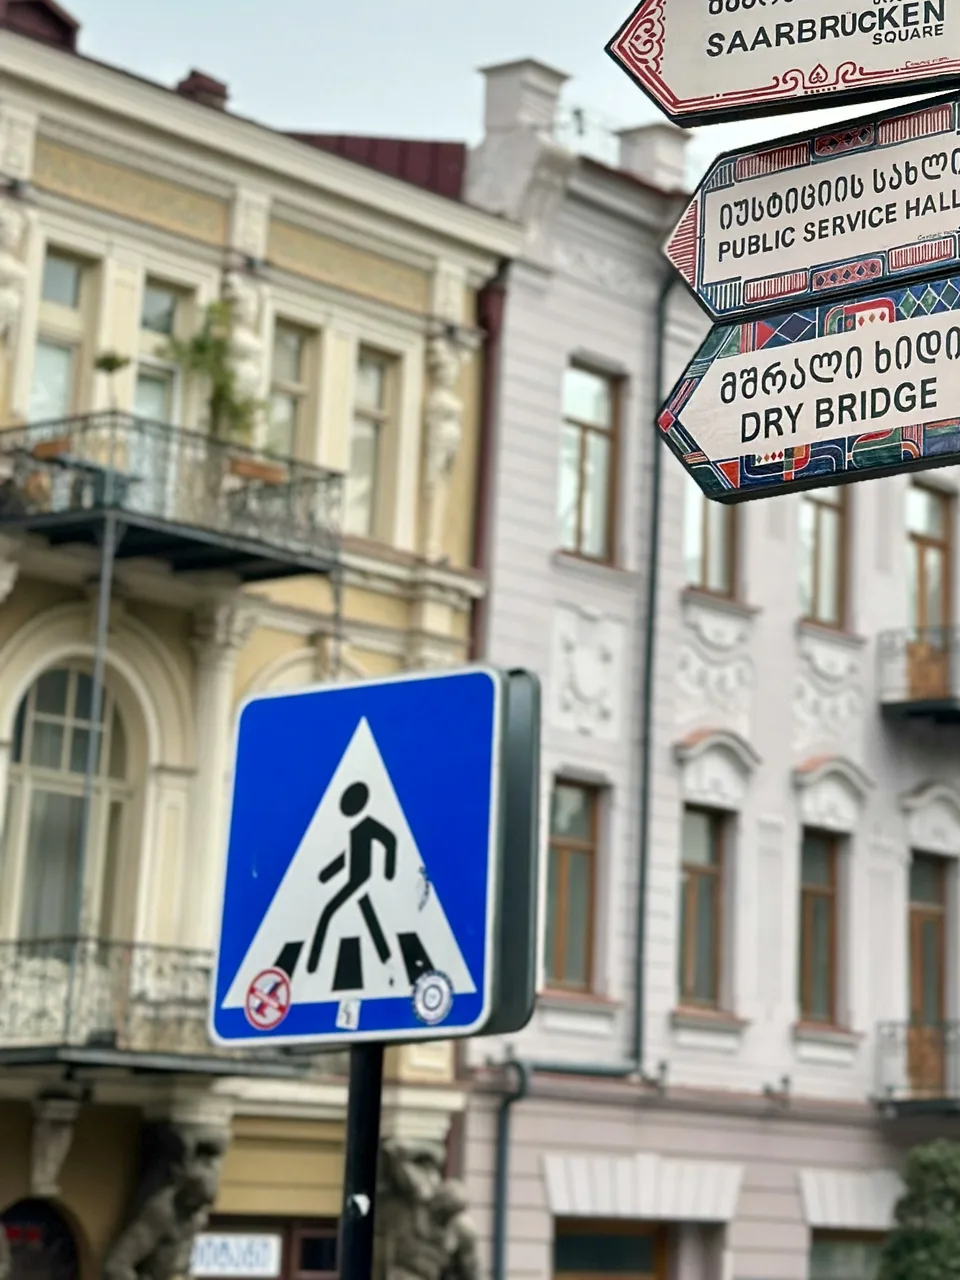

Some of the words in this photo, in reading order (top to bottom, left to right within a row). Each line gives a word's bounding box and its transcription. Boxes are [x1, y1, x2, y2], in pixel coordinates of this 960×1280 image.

[872, 24, 944, 46] SQUARE
[720, 174, 864, 230] იუსტიციის
[718, 227, 795, 262] PUBLIC
[802, 202, 897, 243] SERVICE
[720, 346, 862, 404] მშრალი
[741, 403, 804, 443] DRY
[815, 376, 938, 429] BRIDGE
